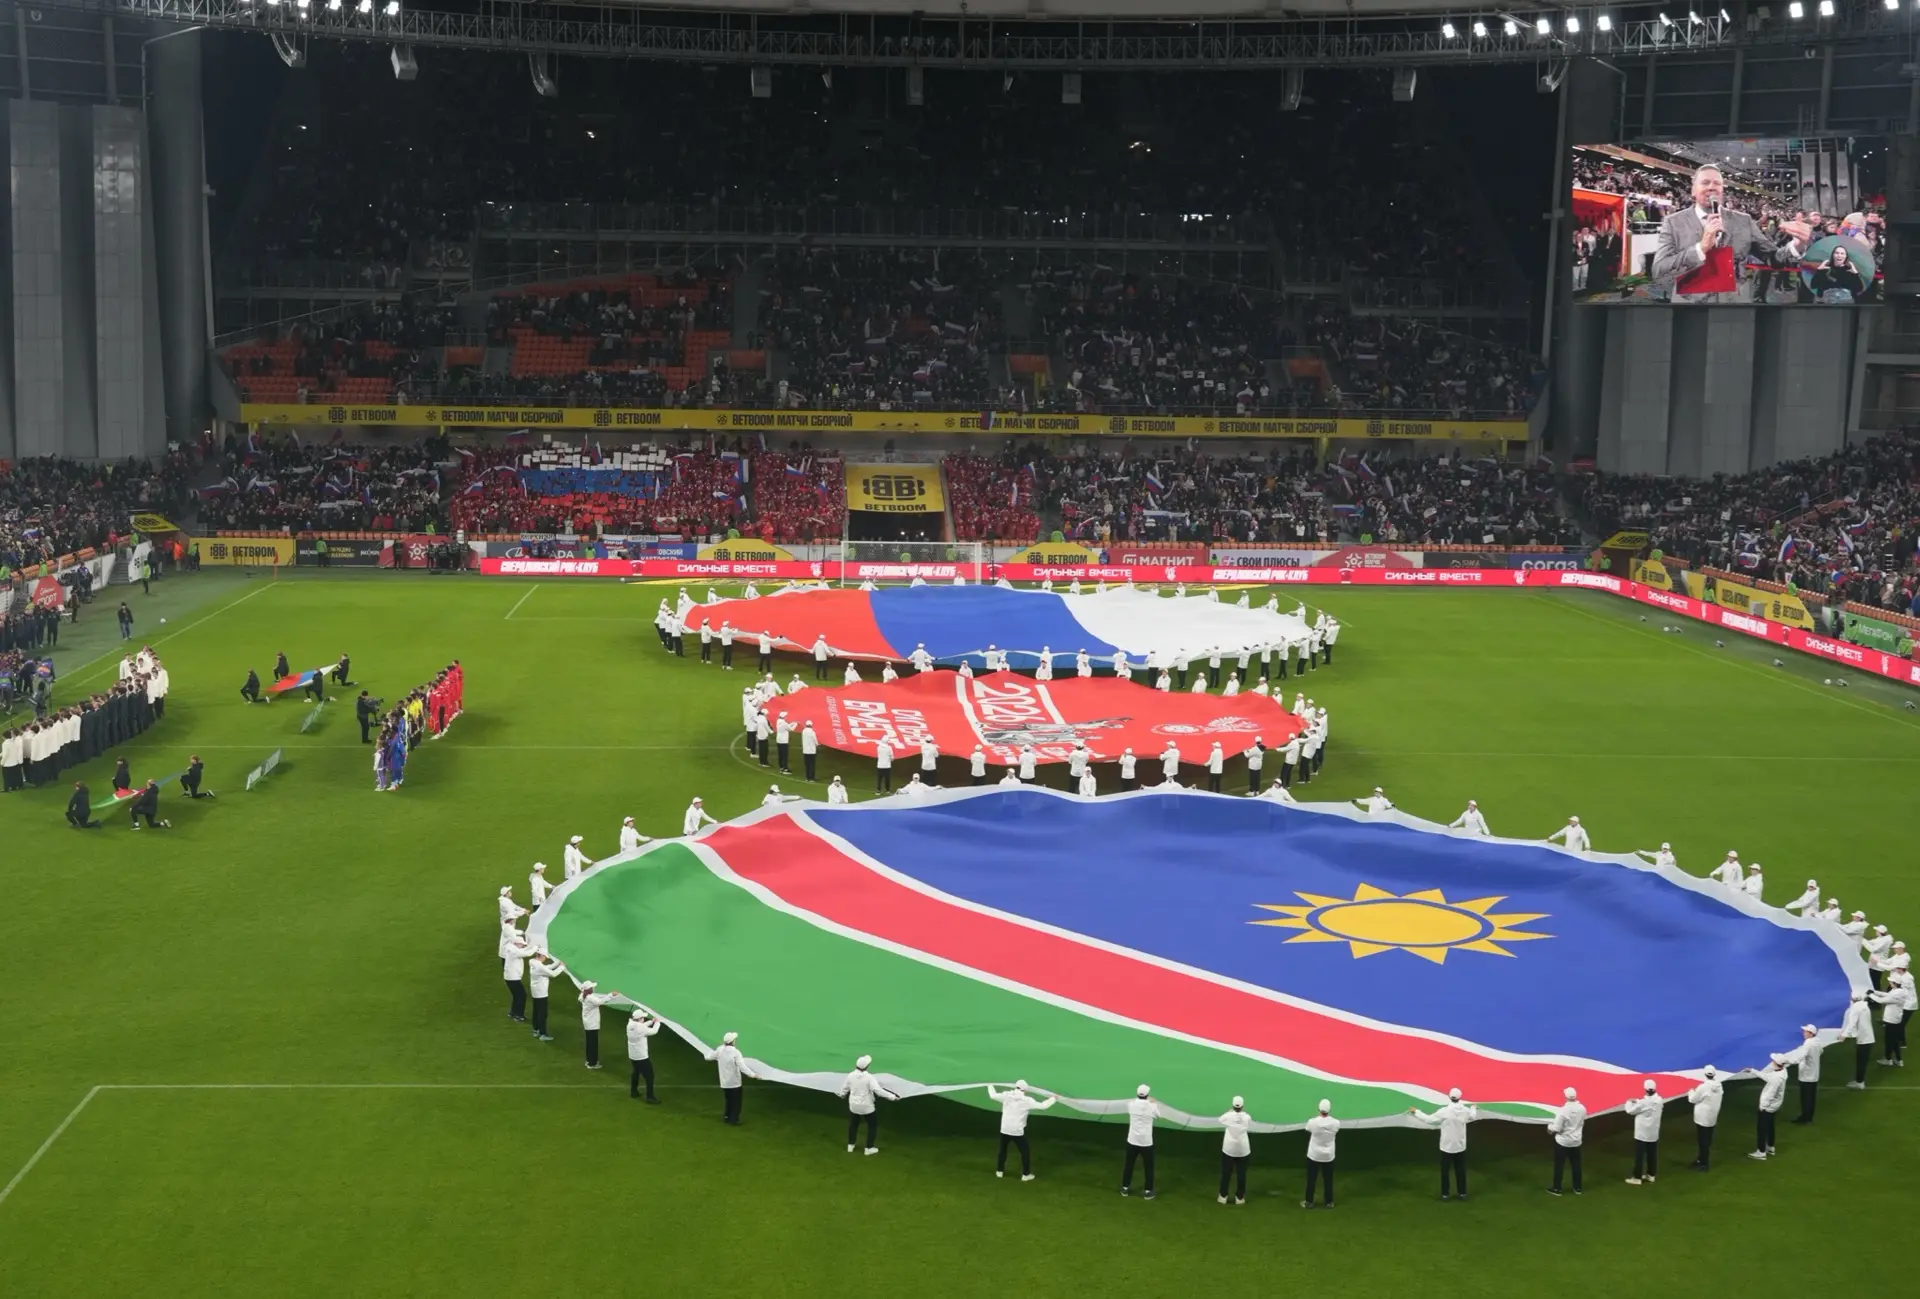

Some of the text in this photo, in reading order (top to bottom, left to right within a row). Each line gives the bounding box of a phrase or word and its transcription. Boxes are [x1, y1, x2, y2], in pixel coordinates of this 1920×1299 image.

[351, 409, 396, 421] BETBOOM
[442, 409, 564, 423] BETBOOM МАТЧИ СБОРНОЙ
[617, 412, 661, 425] BETBOOM
[732, 412, 853, 428] BETBOOM МАТЧИ СБОРНОЙ
[960, 417, 1079, 431] BETBM МАТЧИ СБОРНОЙ
[1132, 420, 1175, 432] BETBOOM
[1219, 420, 1337, 435] BETBOOM МАТЧИ СБОРНОЙ
[1389, 424, 1431, 436] BETBOOM
[865, 504, 927, 512] BETBOOM
[233, 546, 277, 558] BETBOOM
[735, 551, 776, 561] BETBOOM
[1047, 555, 1088, 564] BETBOOM
[1139, 556, 1195, 566] МАГНИТ
[1237, 557, 1300, 567] СВОИ ПЛЮСЫ
[678, 564, 777, 573] СИЛЬНЫЕ ВМЕСТЕ
[1034, 567, 1132, 577] СИЛЬНЫЕ ВМЕСТЕ
[1385, 572, 1482, 581] СИЛЬНЫЕ ВМЕСТЕ
[1836, 645, 1863, 662] ВМЕСТЕ
[973, 680, 1046, 723] 2026
[843, 700, 906, 749] ВМЕСТ
